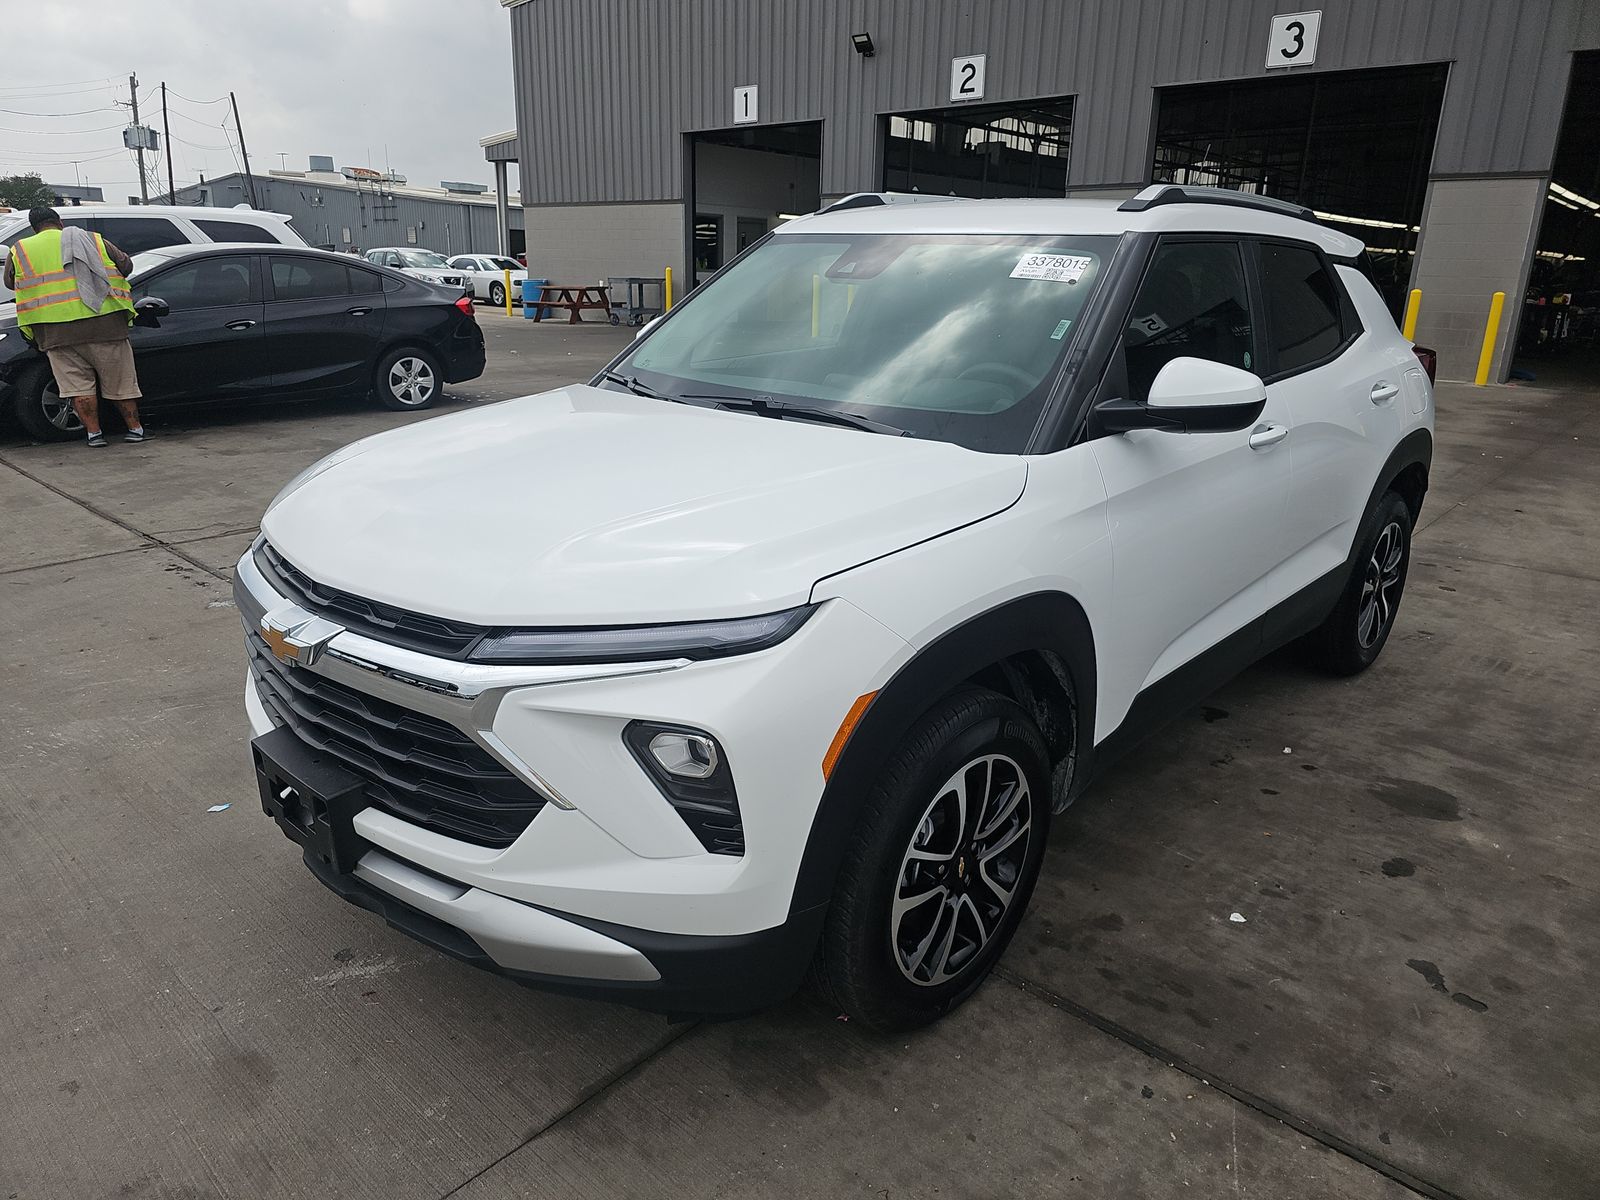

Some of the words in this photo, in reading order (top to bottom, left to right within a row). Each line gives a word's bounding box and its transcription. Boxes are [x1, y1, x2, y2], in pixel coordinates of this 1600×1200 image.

[1280, 21, 1305, 59] 3
[960, 63, 976, 94] 2
[743, 91, 749, 117] 1
[1027, 256, 1089, 270] 3378015
